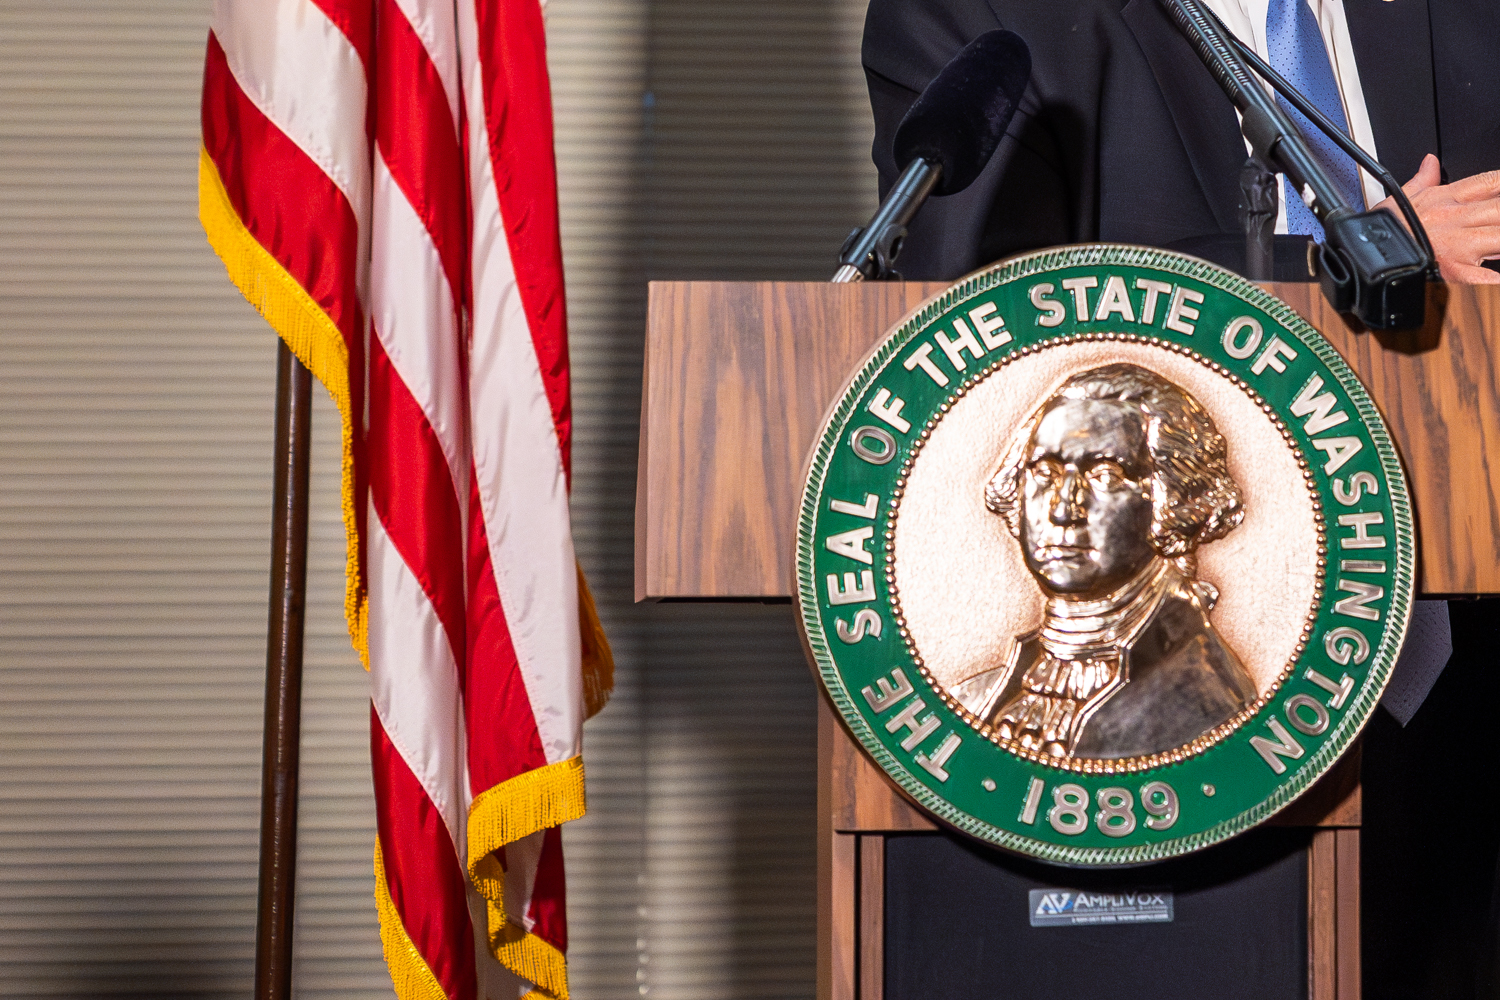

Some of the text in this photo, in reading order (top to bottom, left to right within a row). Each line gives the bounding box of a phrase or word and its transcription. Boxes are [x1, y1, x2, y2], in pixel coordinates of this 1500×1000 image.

[824, 275, 1388, 783] THE SEAL OF THE STATE OF WASHINGTON
[1018, 776, 1181, 838] 1889
